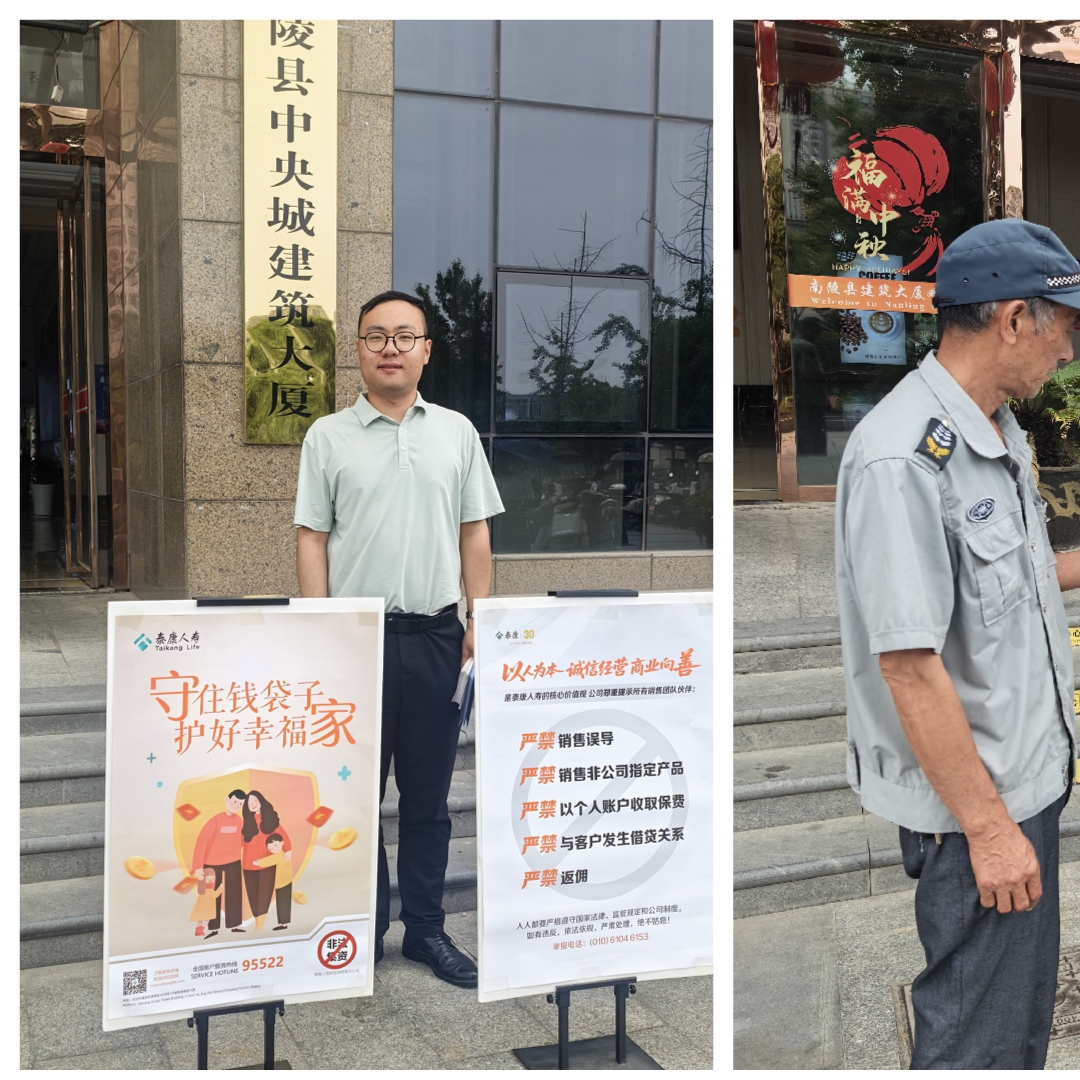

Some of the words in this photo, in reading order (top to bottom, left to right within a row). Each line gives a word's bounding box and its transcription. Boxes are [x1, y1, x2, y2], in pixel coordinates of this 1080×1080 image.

[831, 263, 861, 272] HAPPY
[810, 297, 860, 306] Welcome
[155, 631, 200, 645] 泰康人寿
[523, 629, 535, 640] 30
[150, 670, 324, 722] 守住钱袋子
[174, 698, 356, 755] 护好幸福家
[519, 731, 556, 751] 严禁
[558, 731, 614, 749] 销售误导
[519, 765, 556, 786] 严禁
[558, 761, 684, 783] 销售非公司指定产品
[520, 799, 557, 820] 严禁
[559, 794, 685, 817] 以个人账户收取保费
[521, 834, 558, 855] 严禁
[560, 827, 685, 851] 与客户发生借贷关系
[521, 869, 558, 889] 严禁
[560, 869, 588, 885] 返佣
[609, 934, 629, 944] 6104
[629, 933, 649, 942] 6153
[242, 956, 284, 971] 95522
[191, 971, 214, 979] SERVICE
[214, 968, 239, 977] HOTLINE
